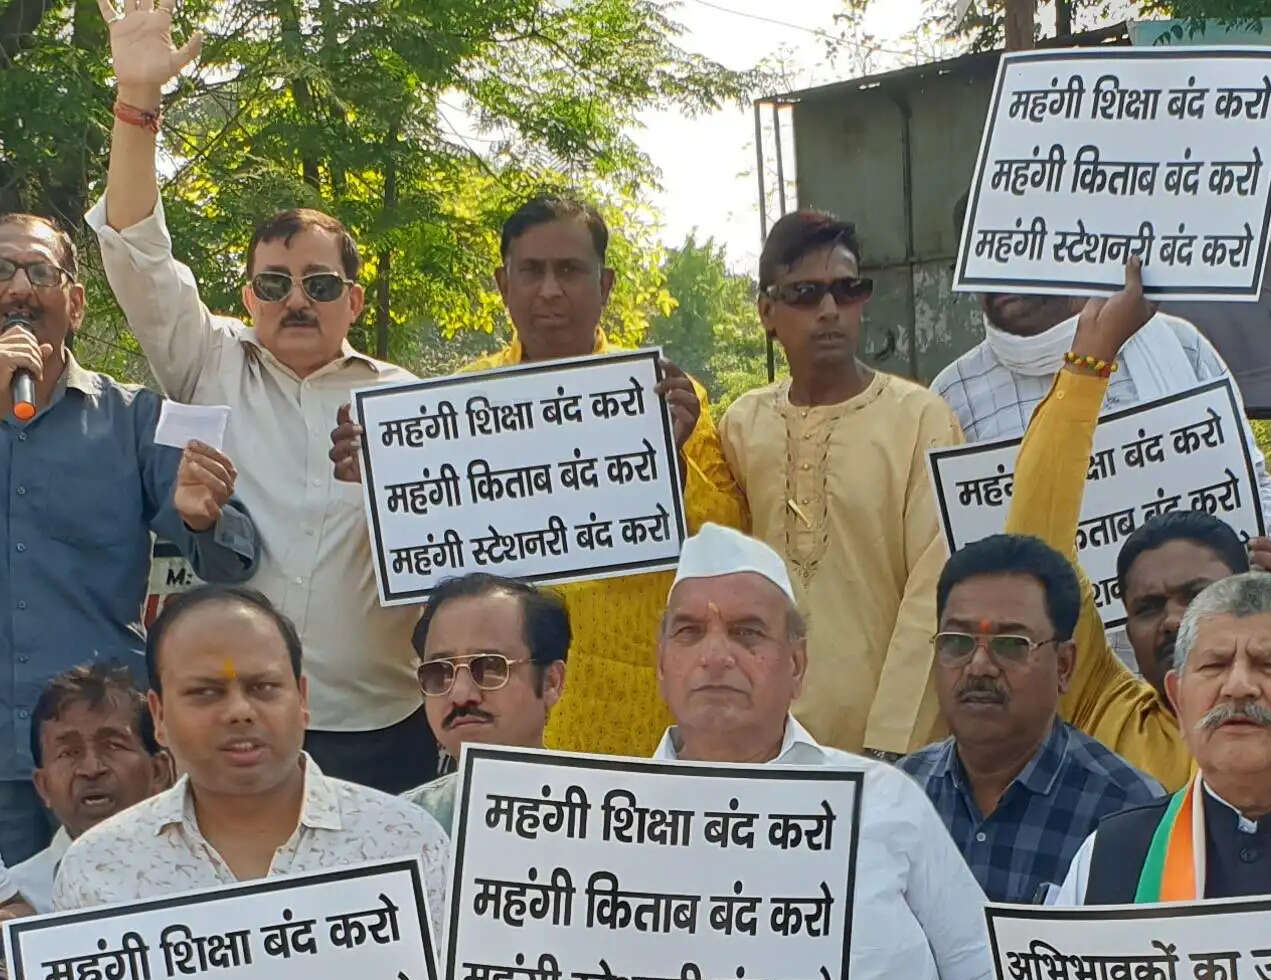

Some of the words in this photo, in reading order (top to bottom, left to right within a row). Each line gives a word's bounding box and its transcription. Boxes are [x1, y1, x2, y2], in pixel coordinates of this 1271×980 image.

[1008, 74, 1086, 123] महंगी
[1091, 74, 1162, 120] शिक्षा
[1167, 75, 1210, 120] बंद
[378, 400, 459, 448] महंगी
[465, 395, 534, 437] शिक्षा
[539, 385, 583, 426] बंद
[588, 376, 645, 419] करो
[1121, 429, 1164, 469] बंद
[1171, 408, 1225, 455] करो
[389, 528, 465, 576] महंगी
[469, 515, 569, 566] स्टेशनरी
[573, 511, 614, 551] बंद
[618, 502, 671, 545] करो
[485, 784, 592, 840] महंगी
[600, 788, 695, 847] शिक्षा
[703, 797, 760, 849] बंद
[767, 799, 837, 851] करो
[158, 923, 252, 978] शिक्षा
[259, 908, 318, 959] बंद
[325, 893, 401, 949] करो
